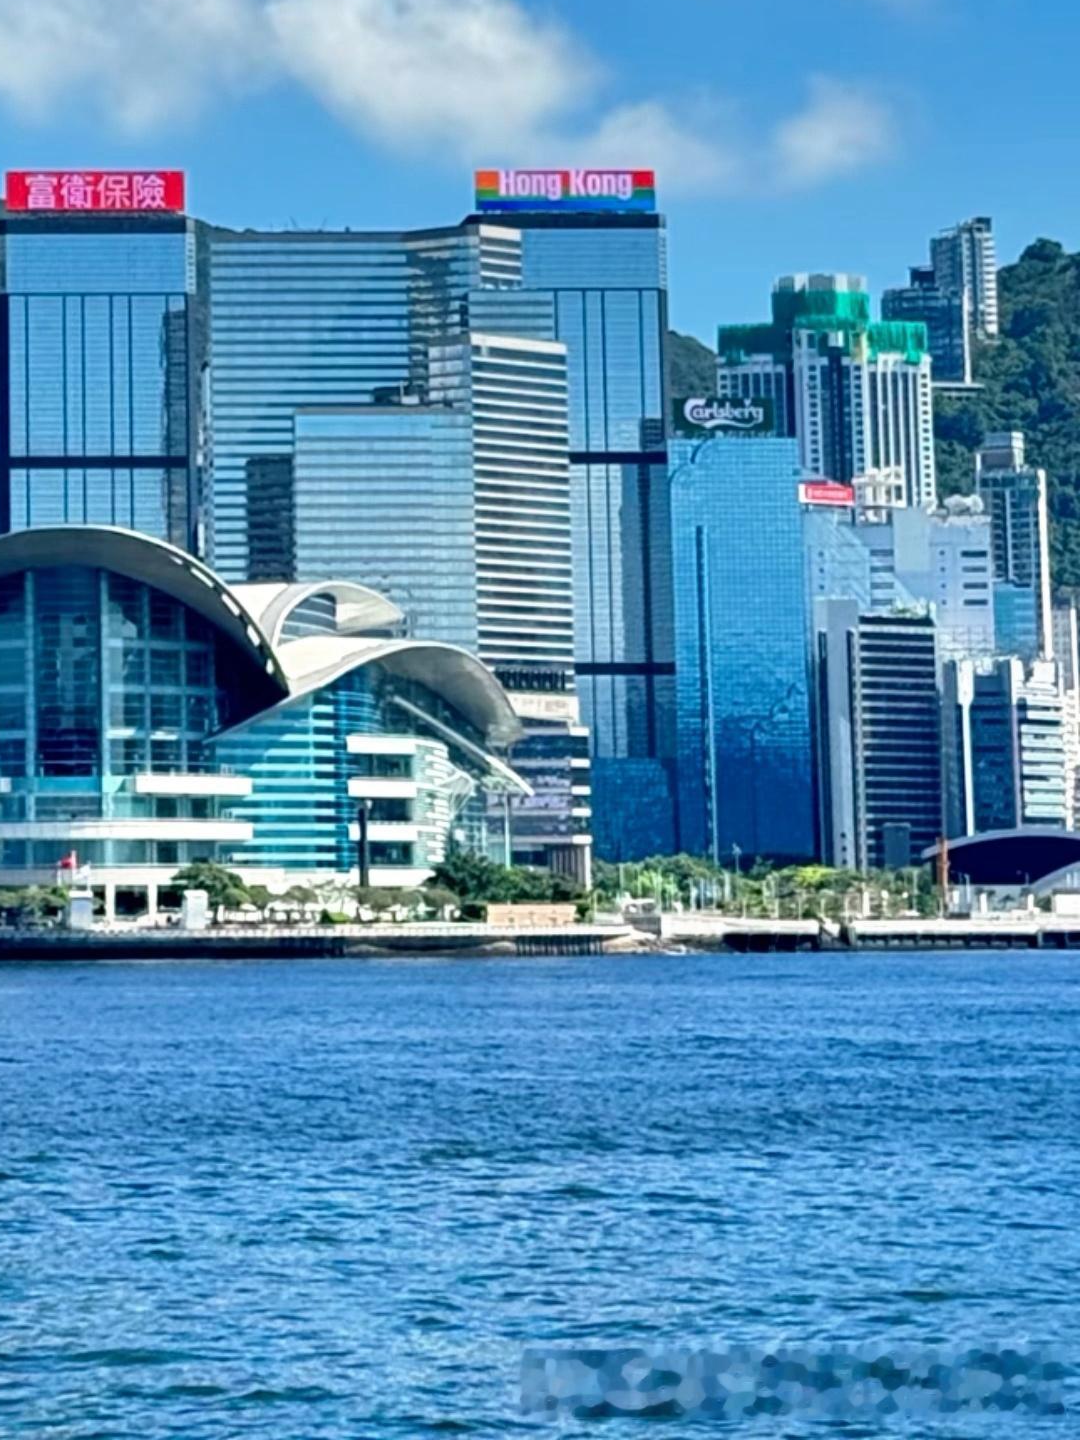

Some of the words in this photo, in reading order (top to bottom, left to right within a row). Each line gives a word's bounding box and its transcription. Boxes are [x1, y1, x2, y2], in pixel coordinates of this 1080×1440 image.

[24, 173, 166, 209] 富衛保險
[498, 170, 561, 201] Hong
[571, 170, 632, 201] Kong
[683, 398, 764, 429] Carlsberg
